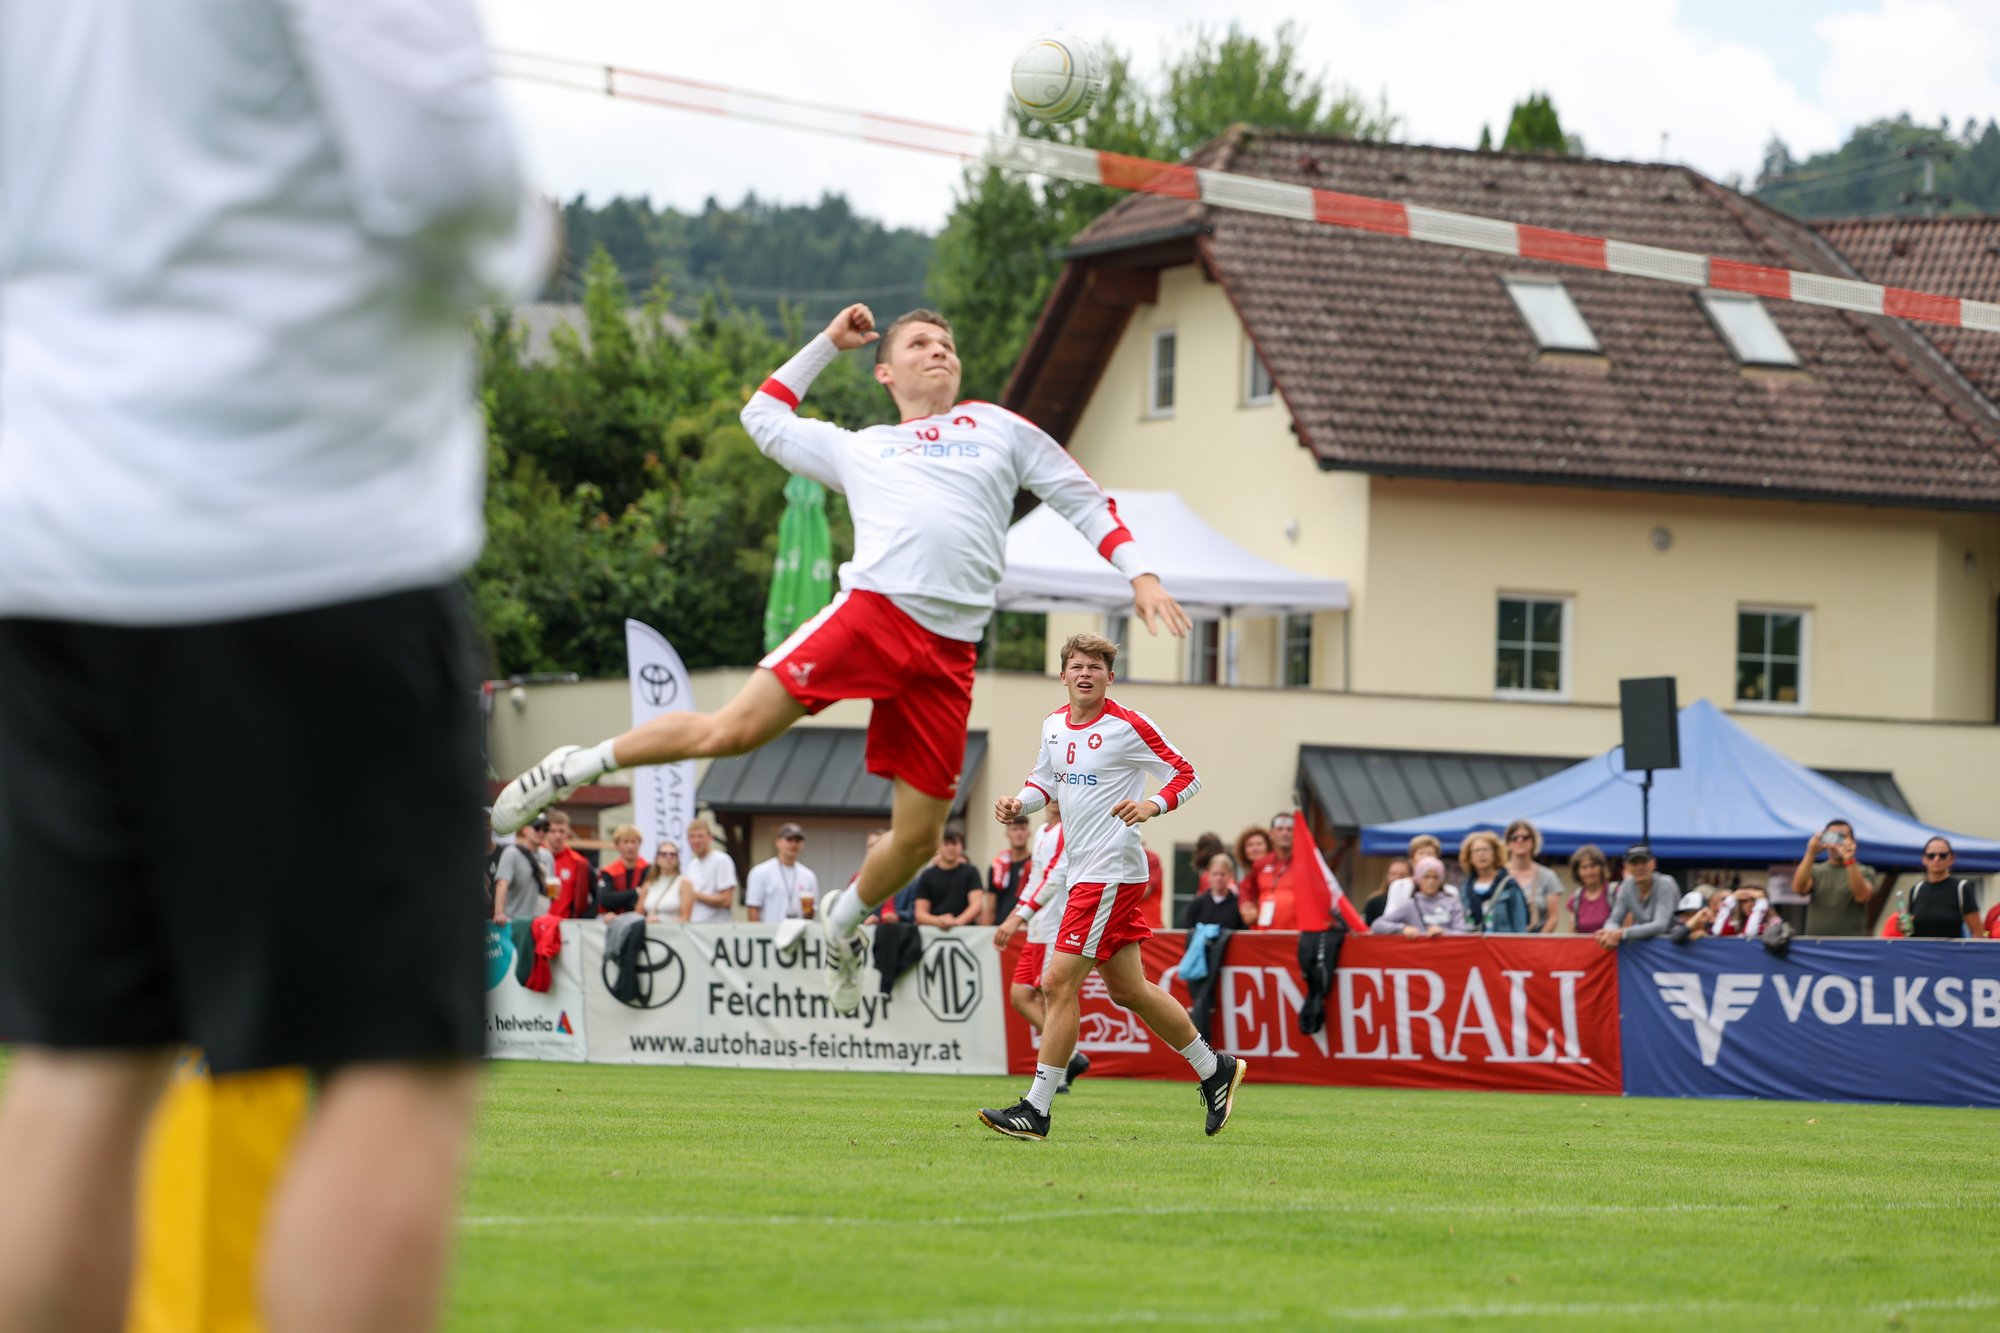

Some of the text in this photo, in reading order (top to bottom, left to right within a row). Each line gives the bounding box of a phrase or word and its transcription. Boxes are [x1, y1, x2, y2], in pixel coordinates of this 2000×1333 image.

[916, 427, 939, 441] 10
[880, 443, 980, 458] axians
[1066, 741, 1076, 765] 6
[1065, 939, 1081, 947] erima
[923, 944, 976, 1014] MG
[1771, 974, 2000, 1029] VOLKSB
[495, 1013, 553, 1031] helvetia
[629, 1031, 962, 1066] www.autohaus-feichtmayr.at
